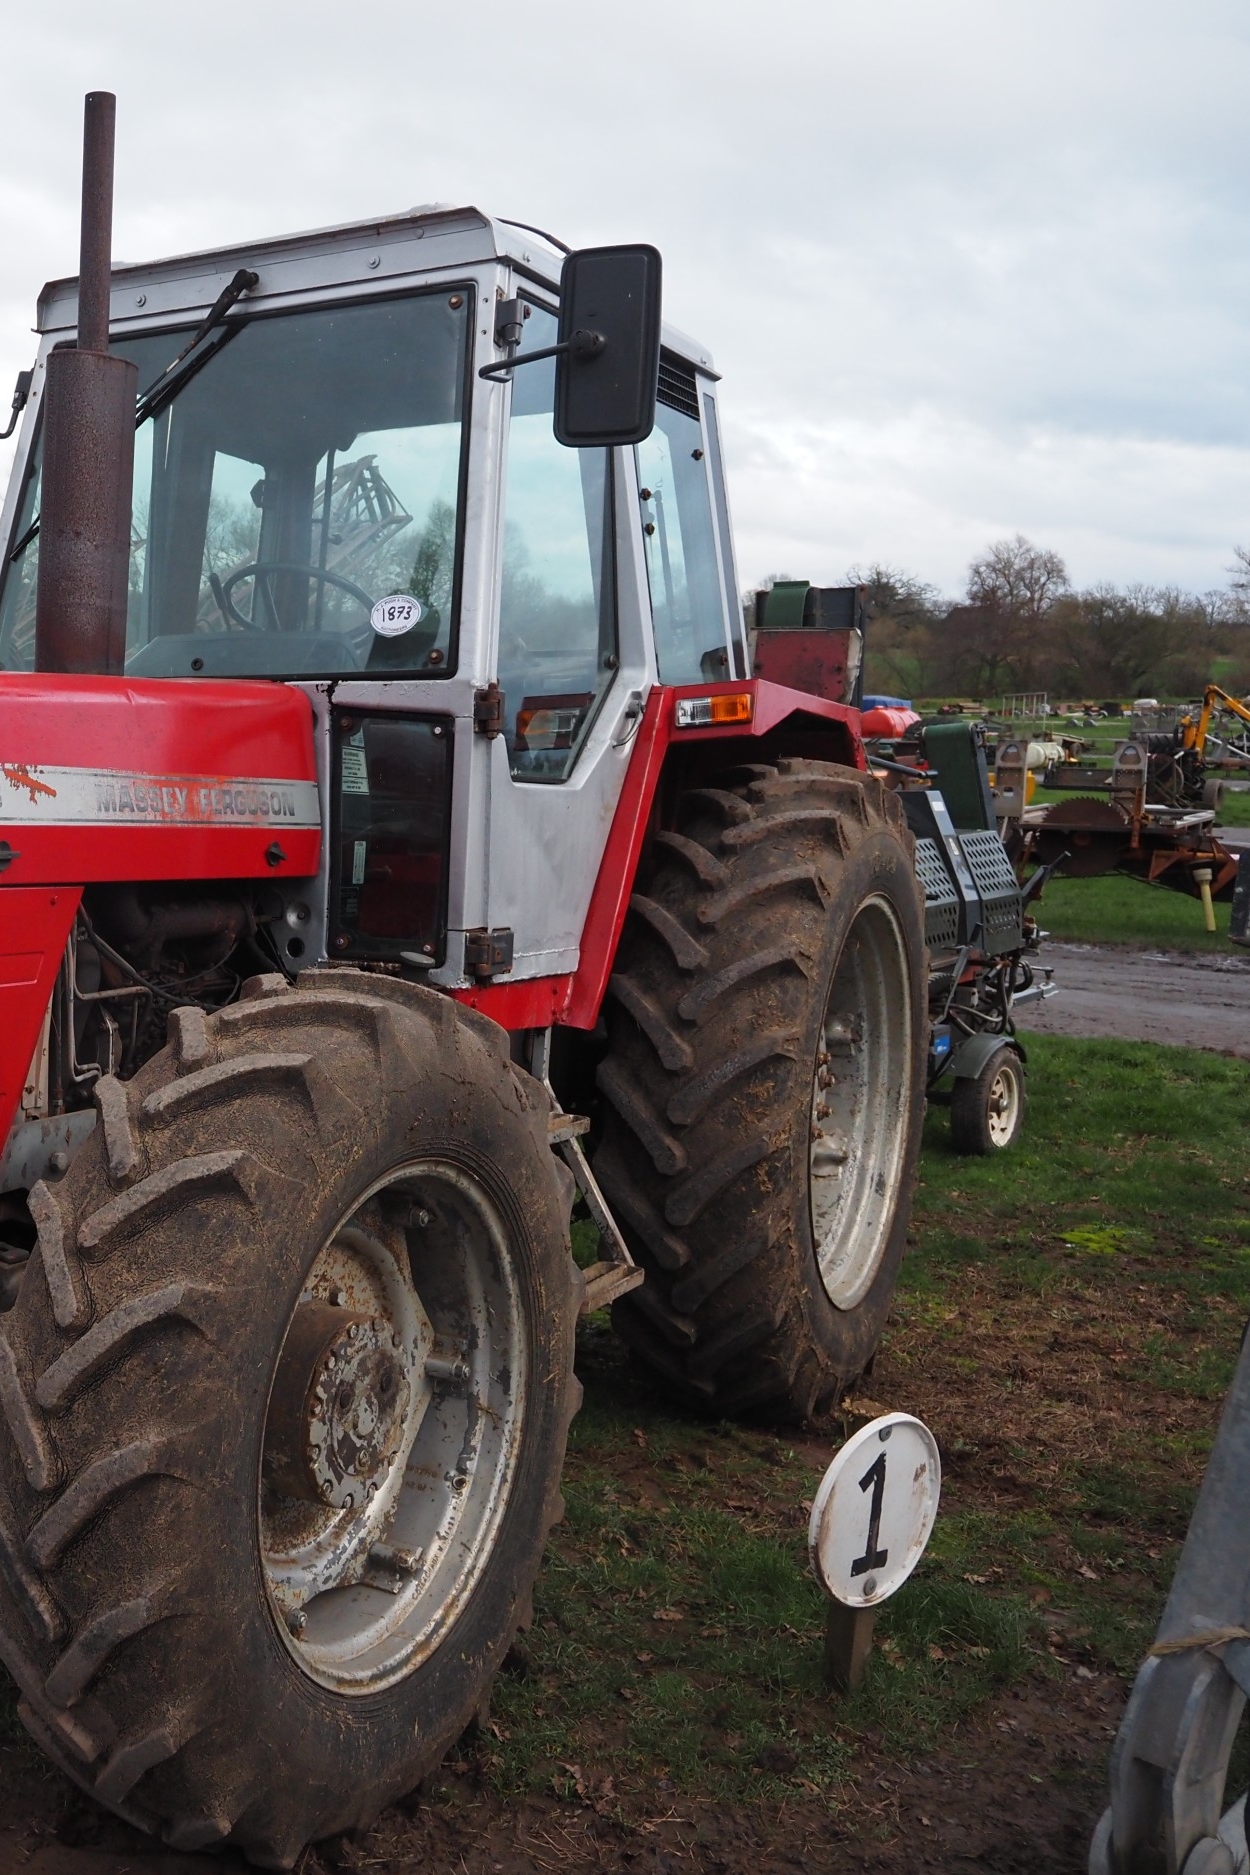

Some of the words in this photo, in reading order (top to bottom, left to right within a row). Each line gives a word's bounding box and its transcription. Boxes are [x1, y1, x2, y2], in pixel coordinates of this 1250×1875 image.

[382, 606, 413, 623] 1873
[95, 783, 188, 815] MASSEY
[199, 787, 296, 817] FERGUSON
[849, 1450, 889, 1578] 1
